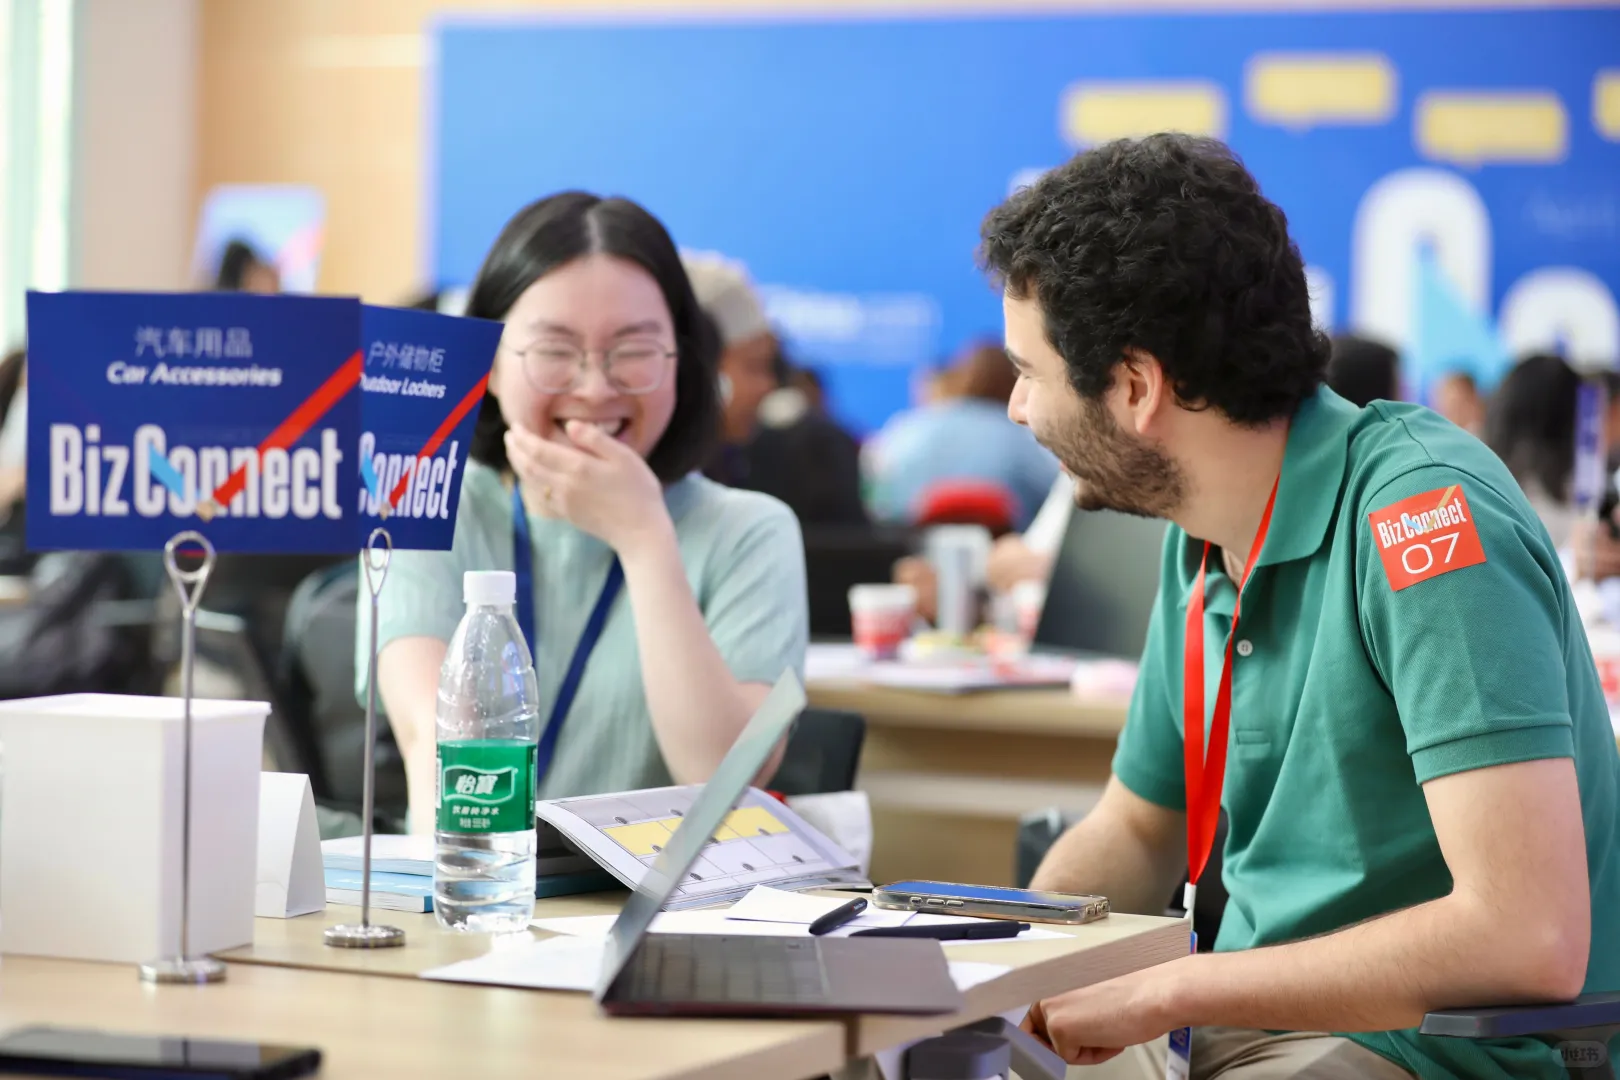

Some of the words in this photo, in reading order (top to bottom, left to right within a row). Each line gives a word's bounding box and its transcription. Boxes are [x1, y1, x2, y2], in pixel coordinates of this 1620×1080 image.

[134, 325, 253, 359] 汽车用品
[366, 339, 447, 373] 户外储物柜
[106, 360, 148, 385] Car
[149, 362, 283, 387] Accessories
[50, 423, 343, 519] BizConnect
[1376, 497, 1467, 549] BizConnect
[1401, 531, 1460, 575] 07
